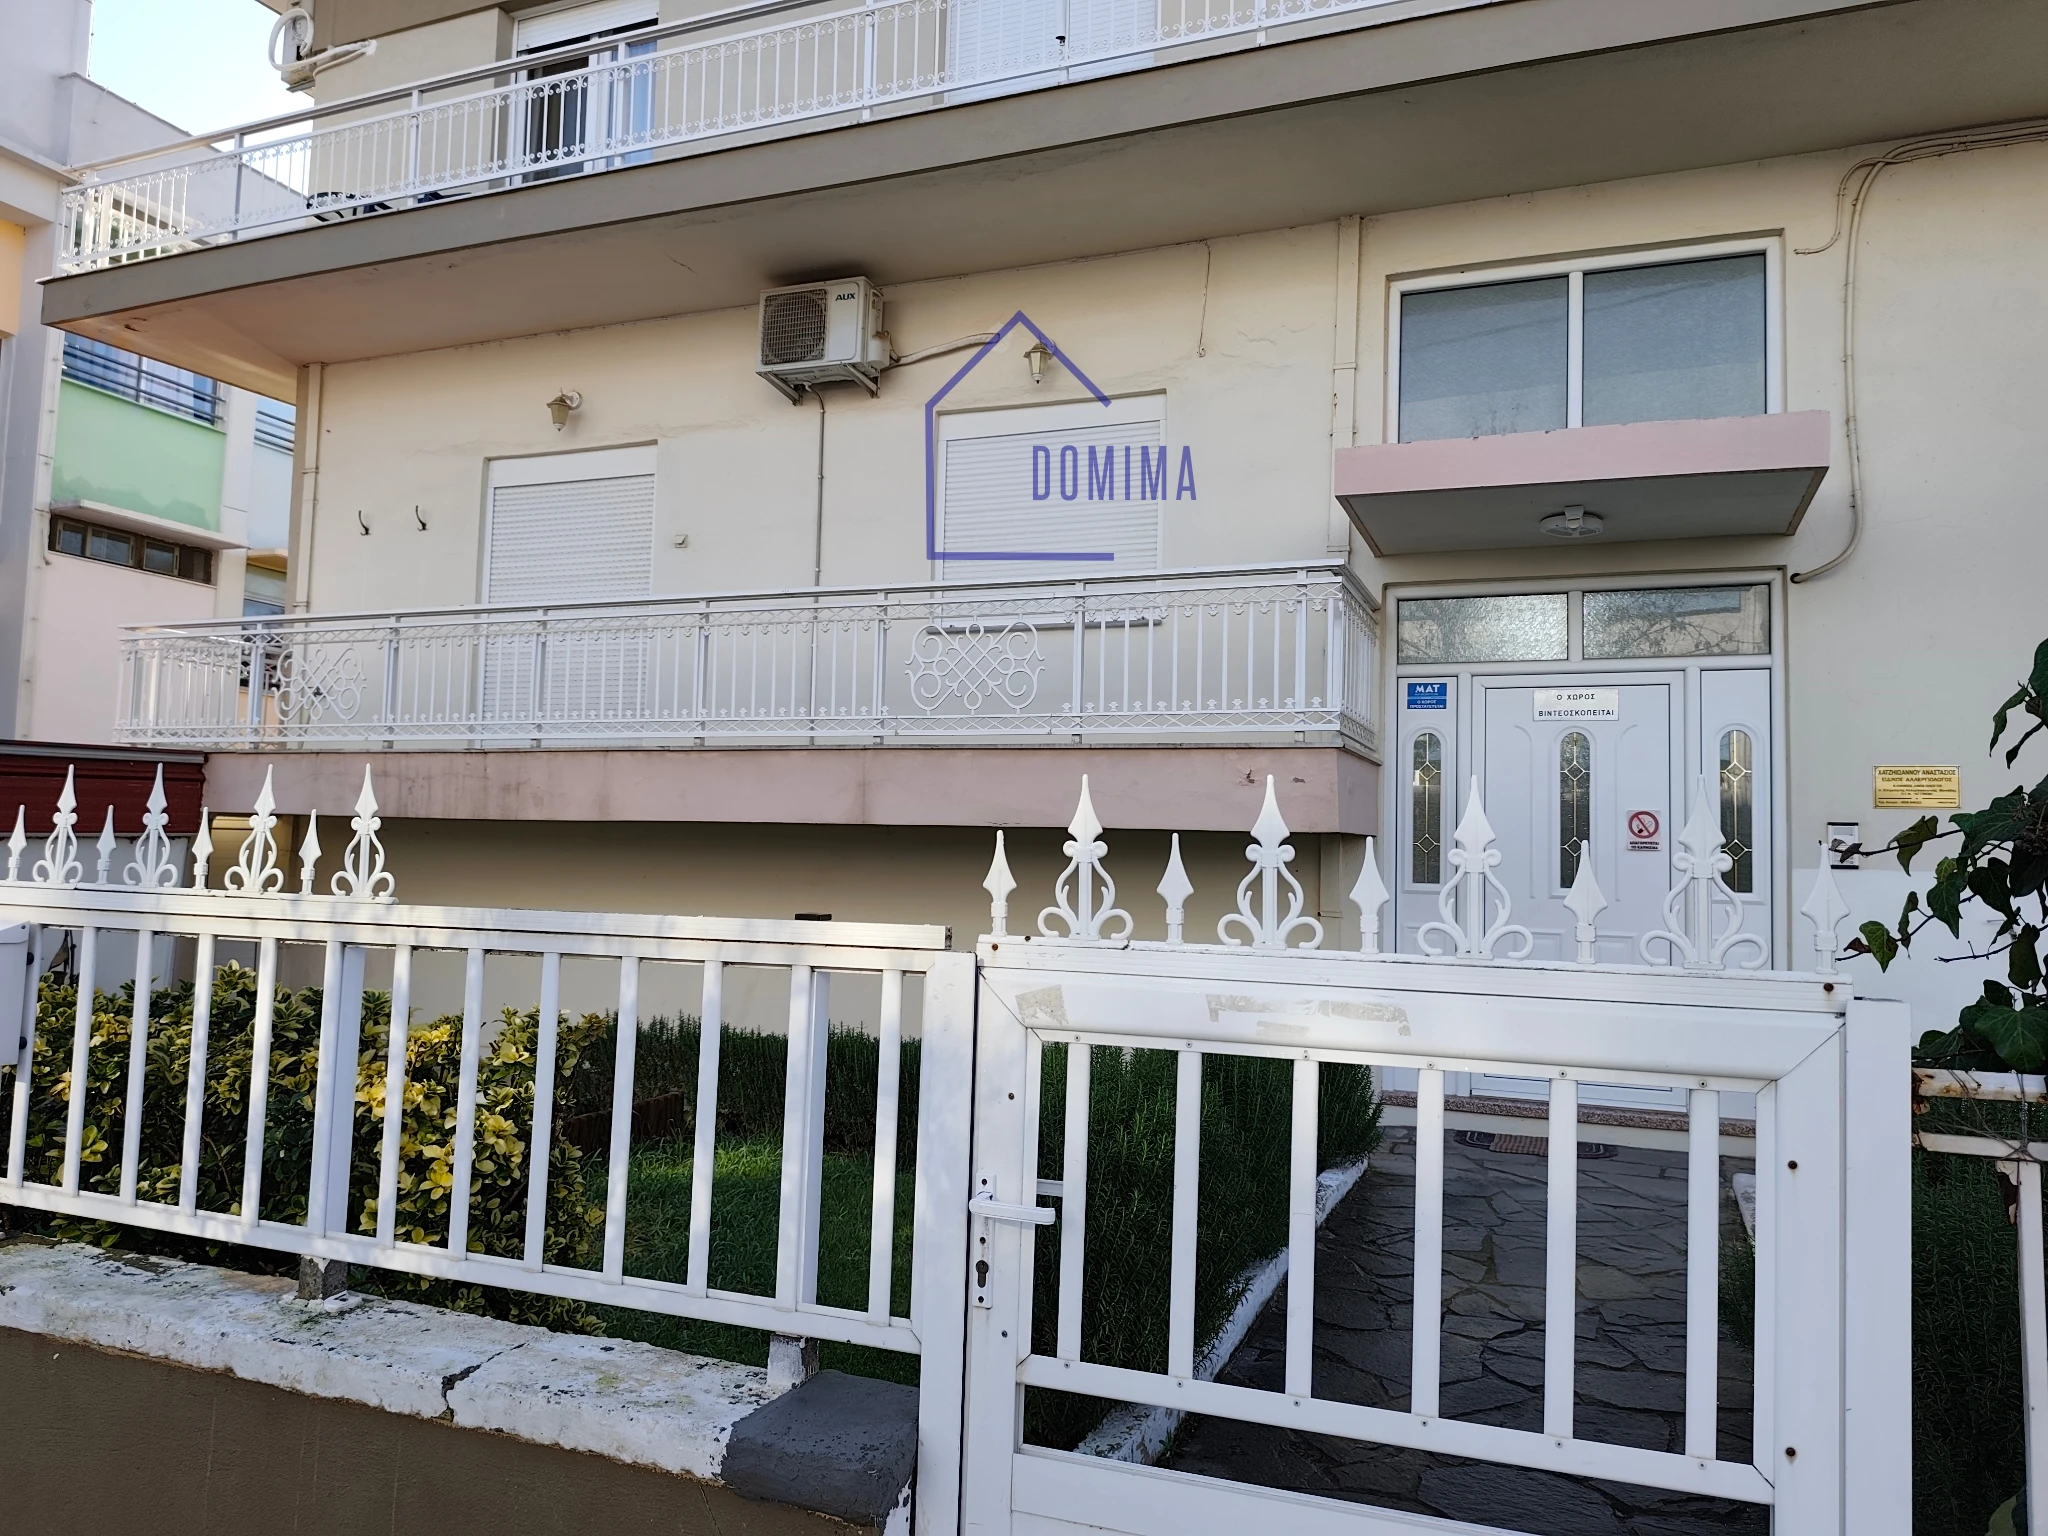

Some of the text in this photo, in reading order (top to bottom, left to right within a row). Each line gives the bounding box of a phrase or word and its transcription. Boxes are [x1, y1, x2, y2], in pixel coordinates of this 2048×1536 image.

[835, 292, 856, 301] AUX
[1566, 693, 1596, 701] ΧΩΡΟΣ
[1538, 709, 1615, 717] ΒΙΝΤΕΟΣΚΟΠΕΙΤΑΙ
